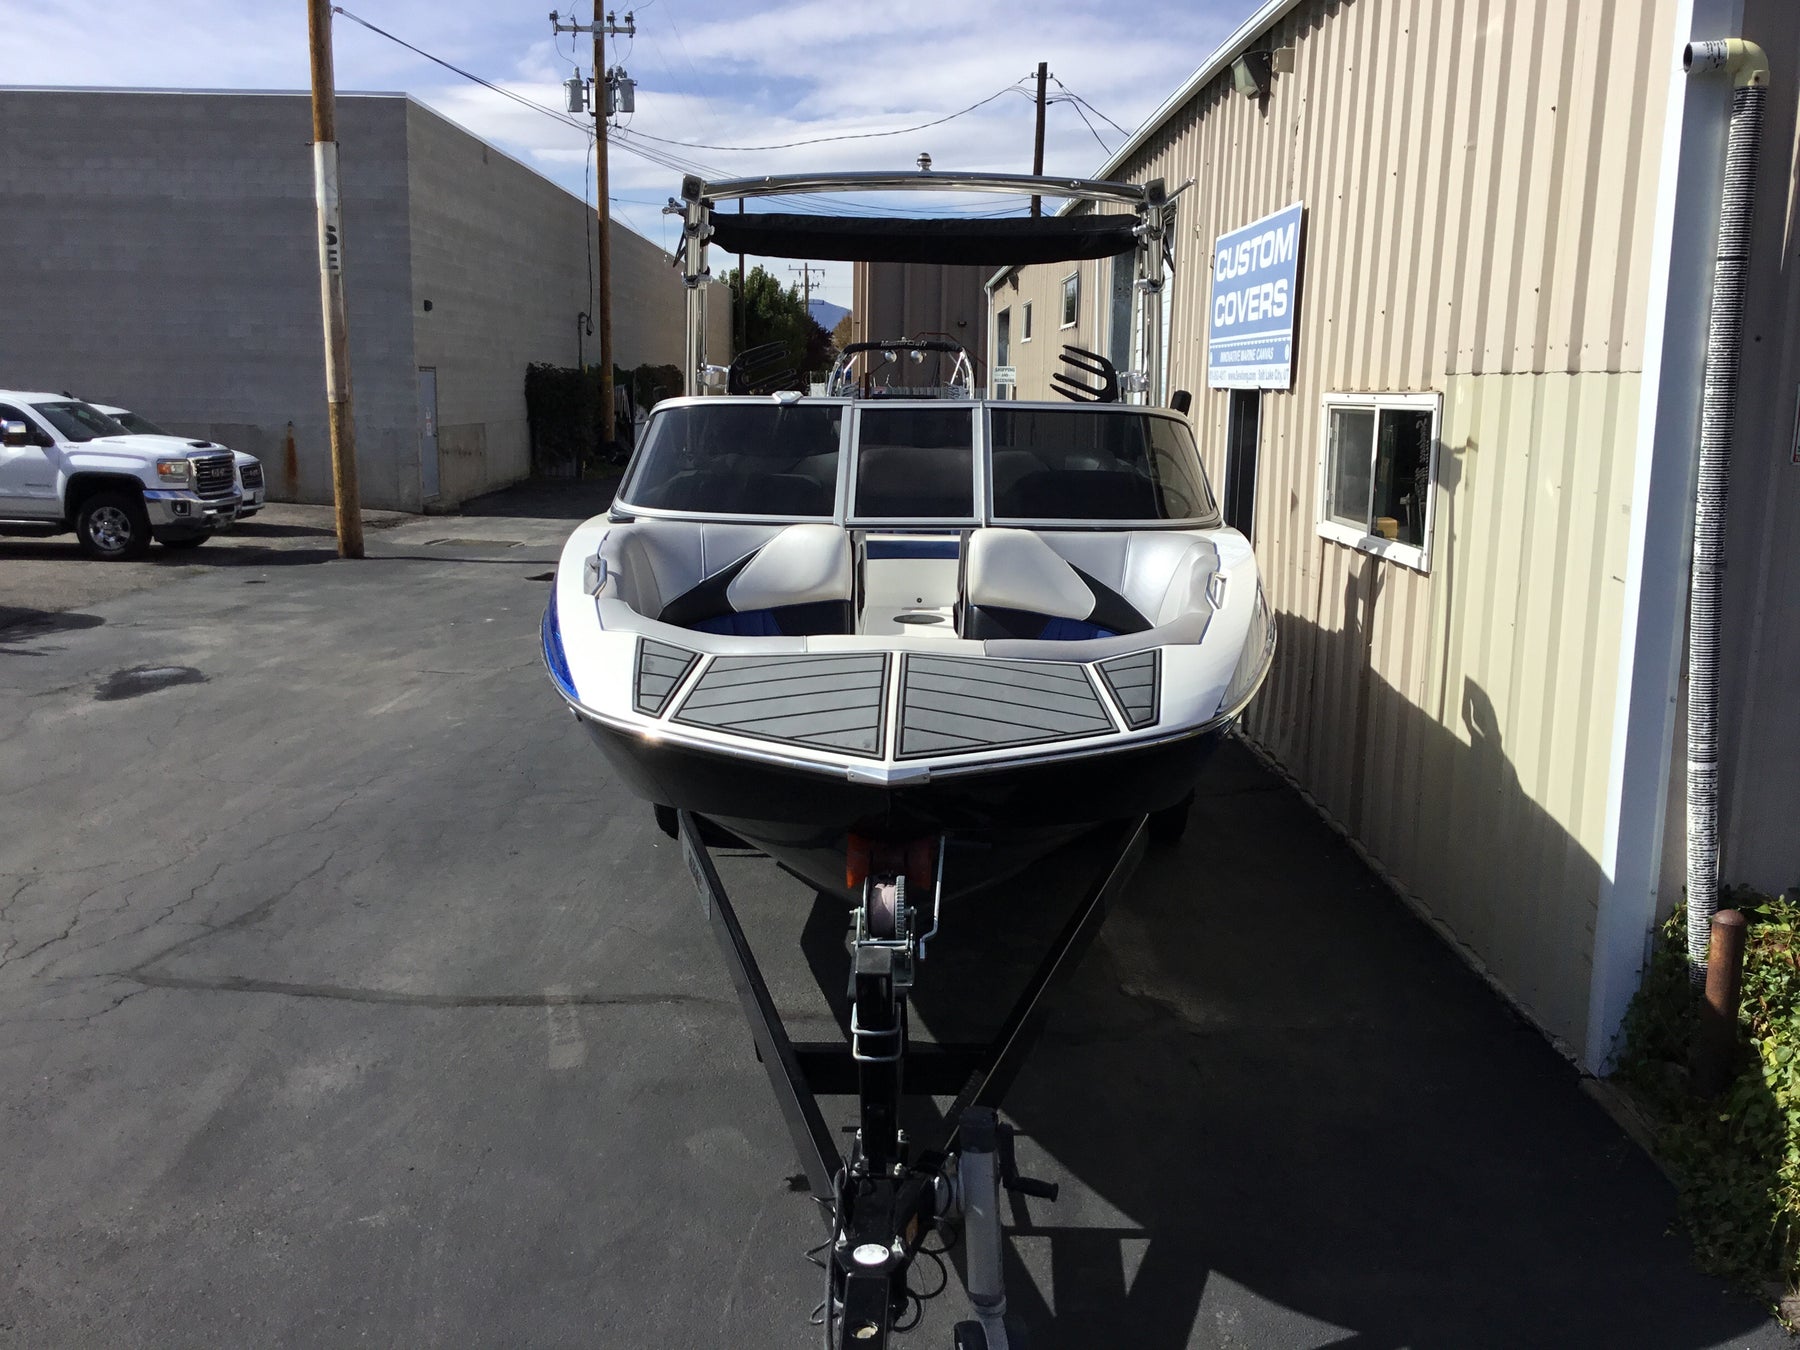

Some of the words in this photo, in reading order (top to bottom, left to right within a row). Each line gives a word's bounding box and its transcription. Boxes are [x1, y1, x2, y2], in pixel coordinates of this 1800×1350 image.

[1216, 222, 1295, 282] CUSTOM
[1214, 278, 1288, 327] COVERS
[1256, 347, 1274, 360] CANVAS
